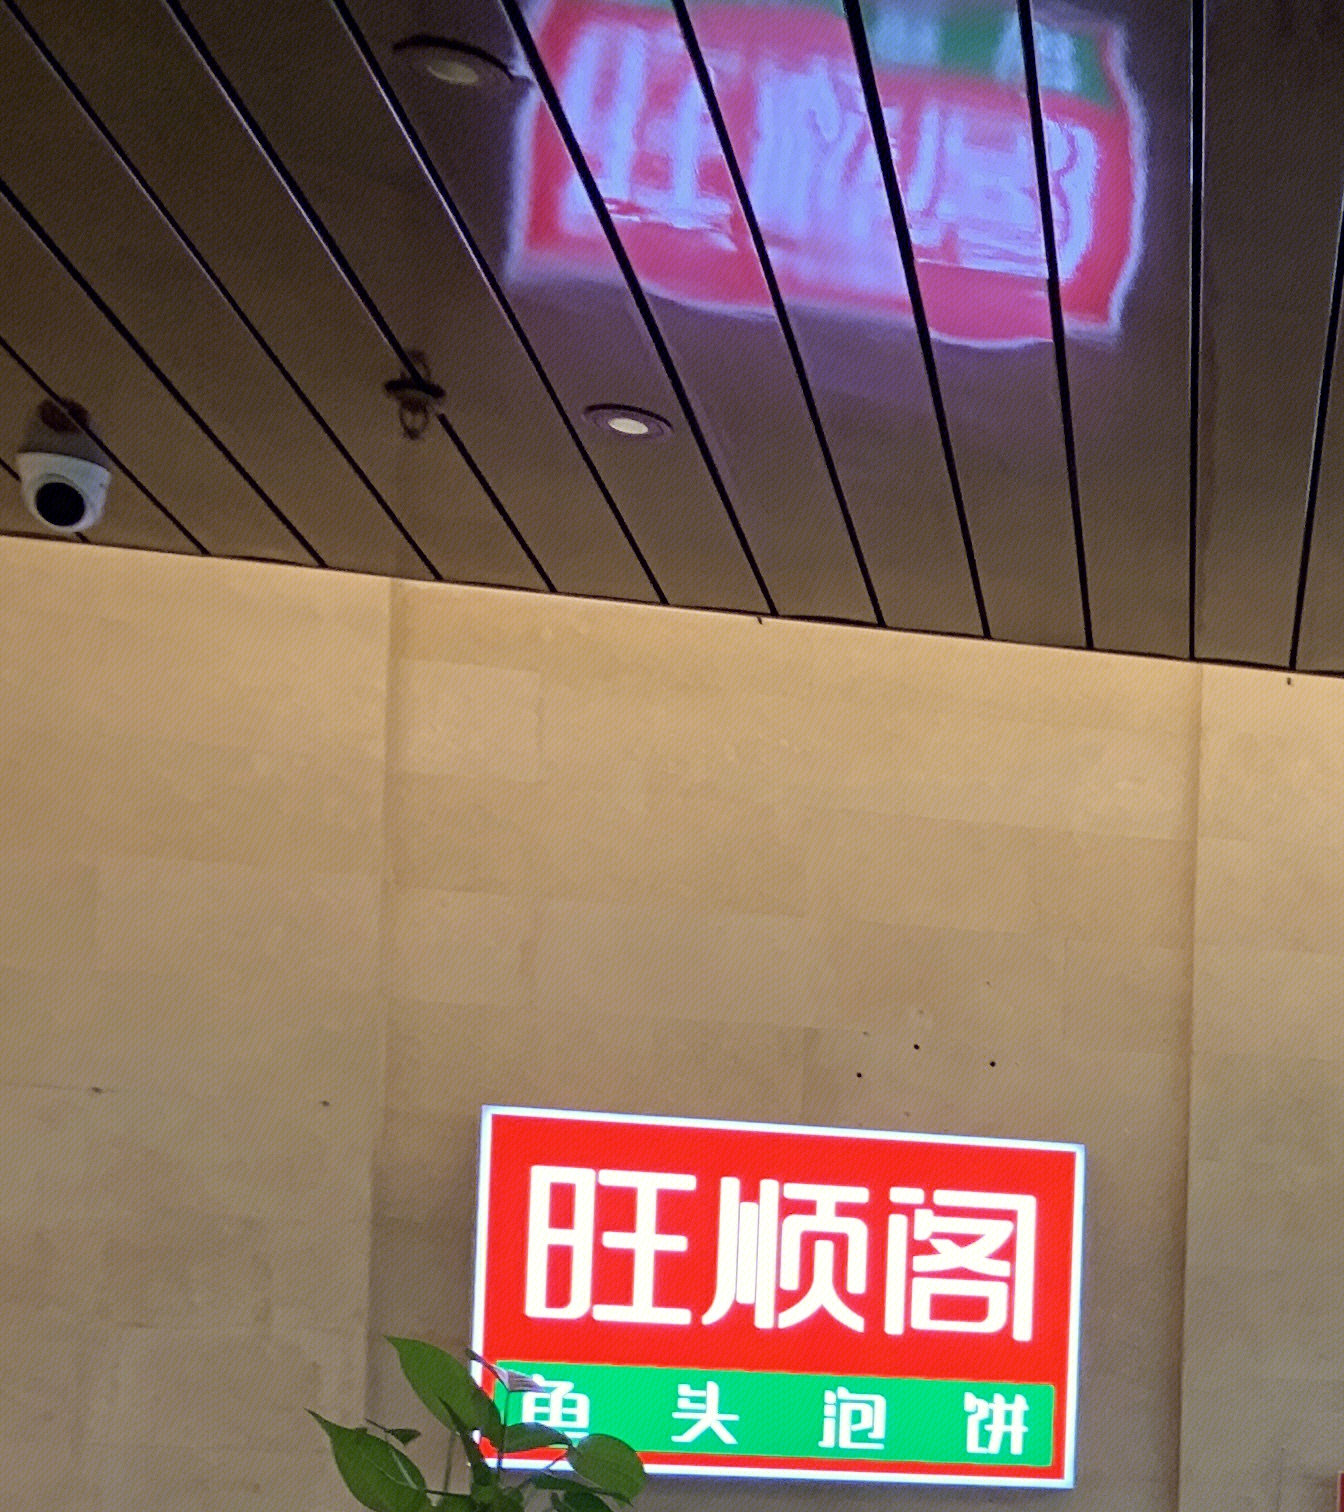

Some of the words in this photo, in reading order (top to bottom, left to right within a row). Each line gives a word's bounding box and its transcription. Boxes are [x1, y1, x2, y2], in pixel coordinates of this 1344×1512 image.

[524, 1163, 1038, 1343] 旺顺阁
[521, 1372, 1031, 1456] 鱼头泡饼
